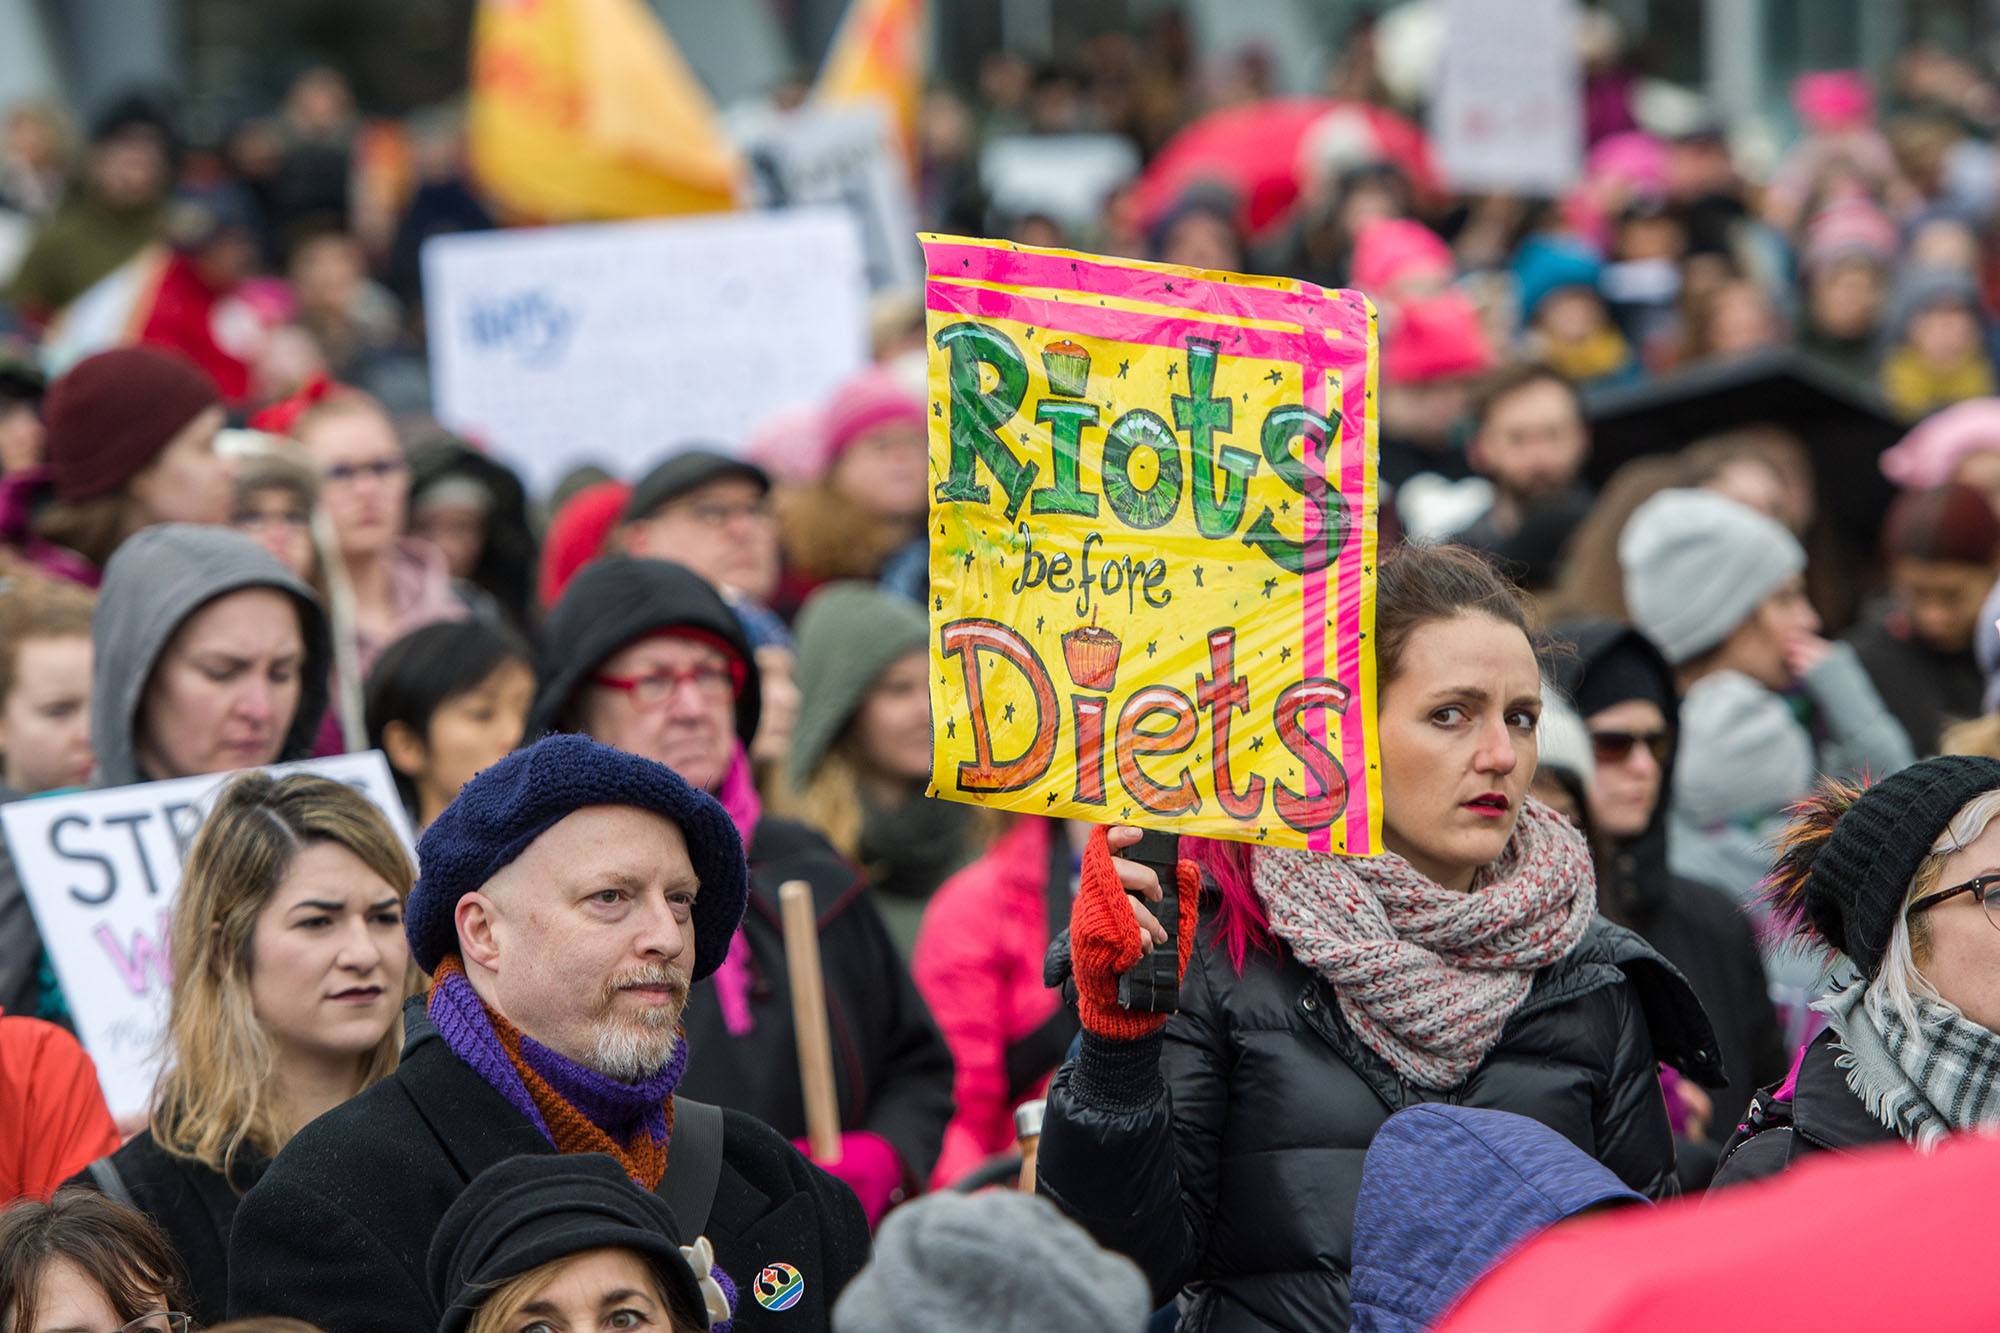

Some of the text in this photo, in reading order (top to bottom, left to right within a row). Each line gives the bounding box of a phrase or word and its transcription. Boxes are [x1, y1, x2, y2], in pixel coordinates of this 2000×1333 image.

[933, 322, 1352, 574] Riots
[1012, 521, 1171, 617] before
[941, 617, 1351, 832] Diets
